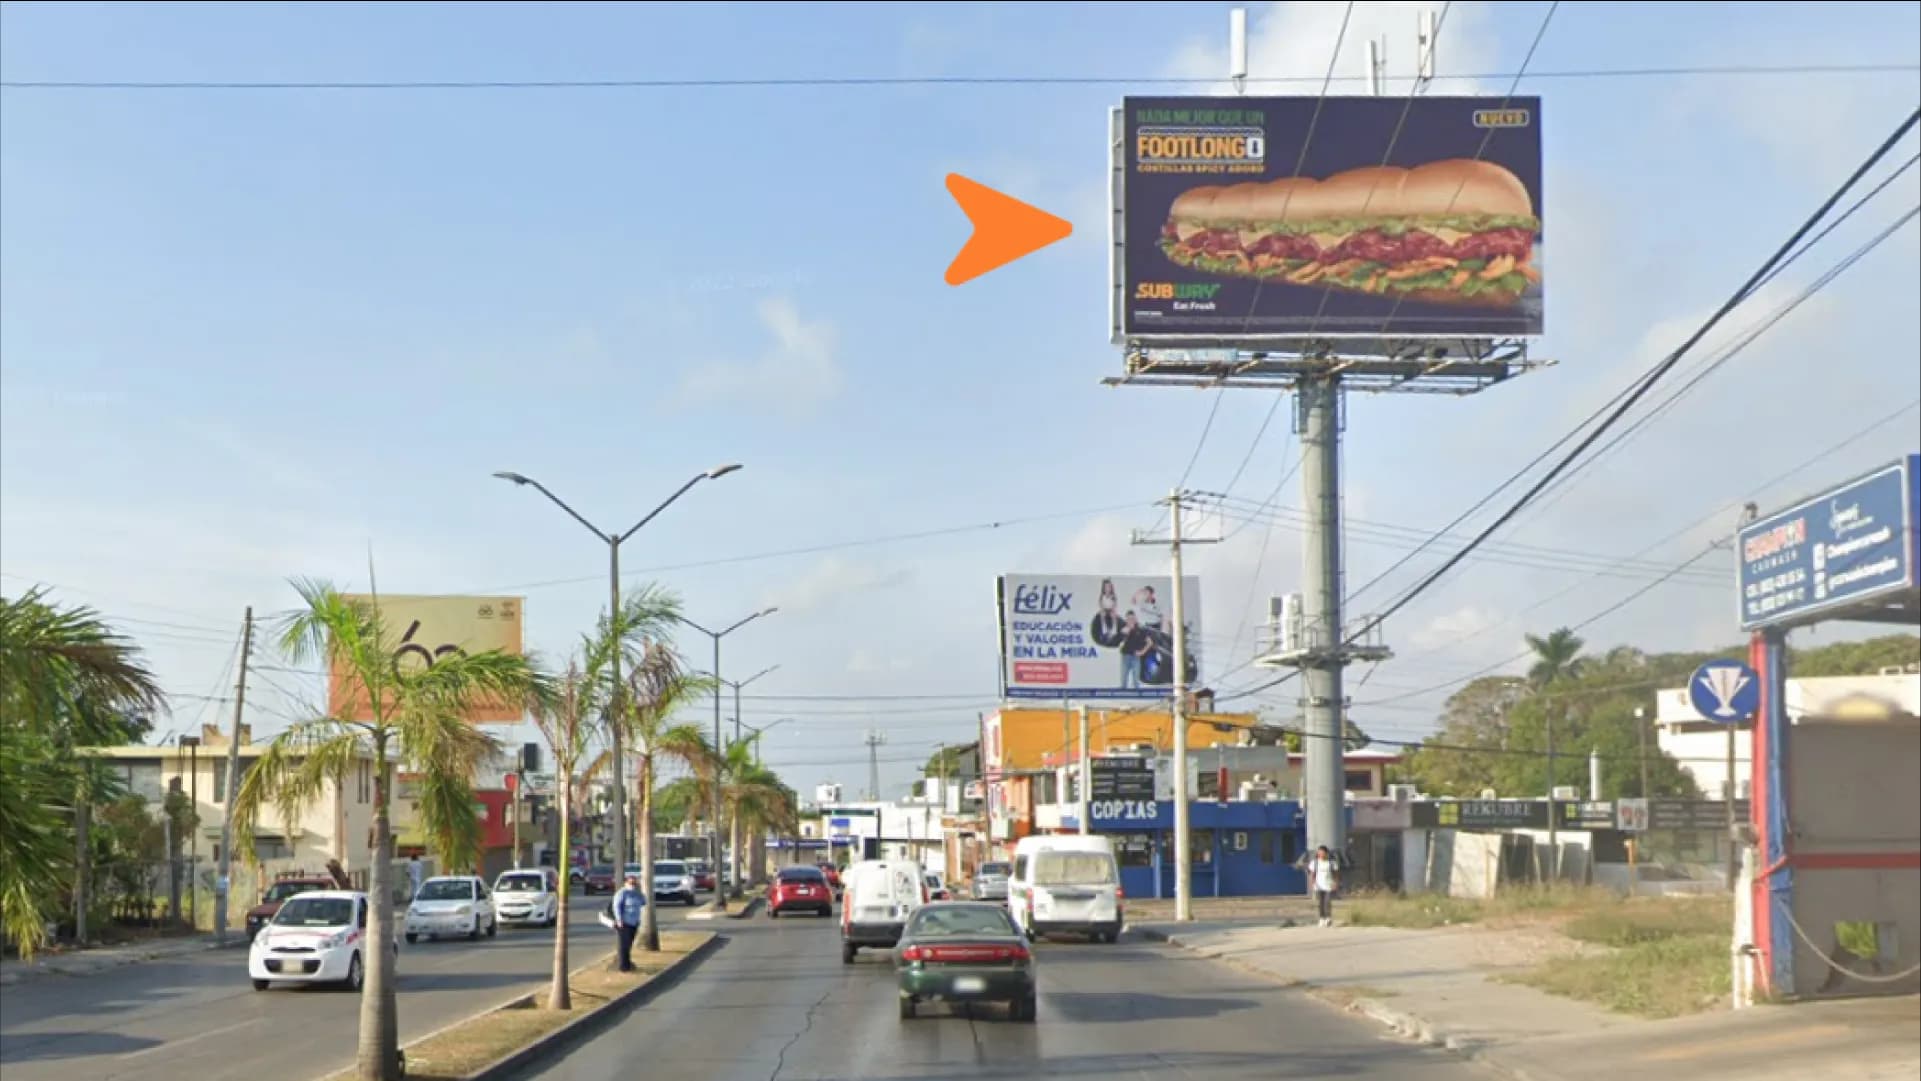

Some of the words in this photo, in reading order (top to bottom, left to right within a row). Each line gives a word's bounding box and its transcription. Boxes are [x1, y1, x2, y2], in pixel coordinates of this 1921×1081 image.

[1173, 109, 1216, 123] MEJOR
[1135, 283, 1221, 299] SUBWAY
[1013, 619, 1082, 631] EDUCACIÓN
[1013, 634, 1023, 644] Y
[1026, 634, 1084, 645] VALORES
[1013, 646, 1034, 658] EN
[1037, 646, 1057, 658] LA
[1060, 646, 1098, 659] MIRA
[1091, 800, 1158, 820] COPIAS
